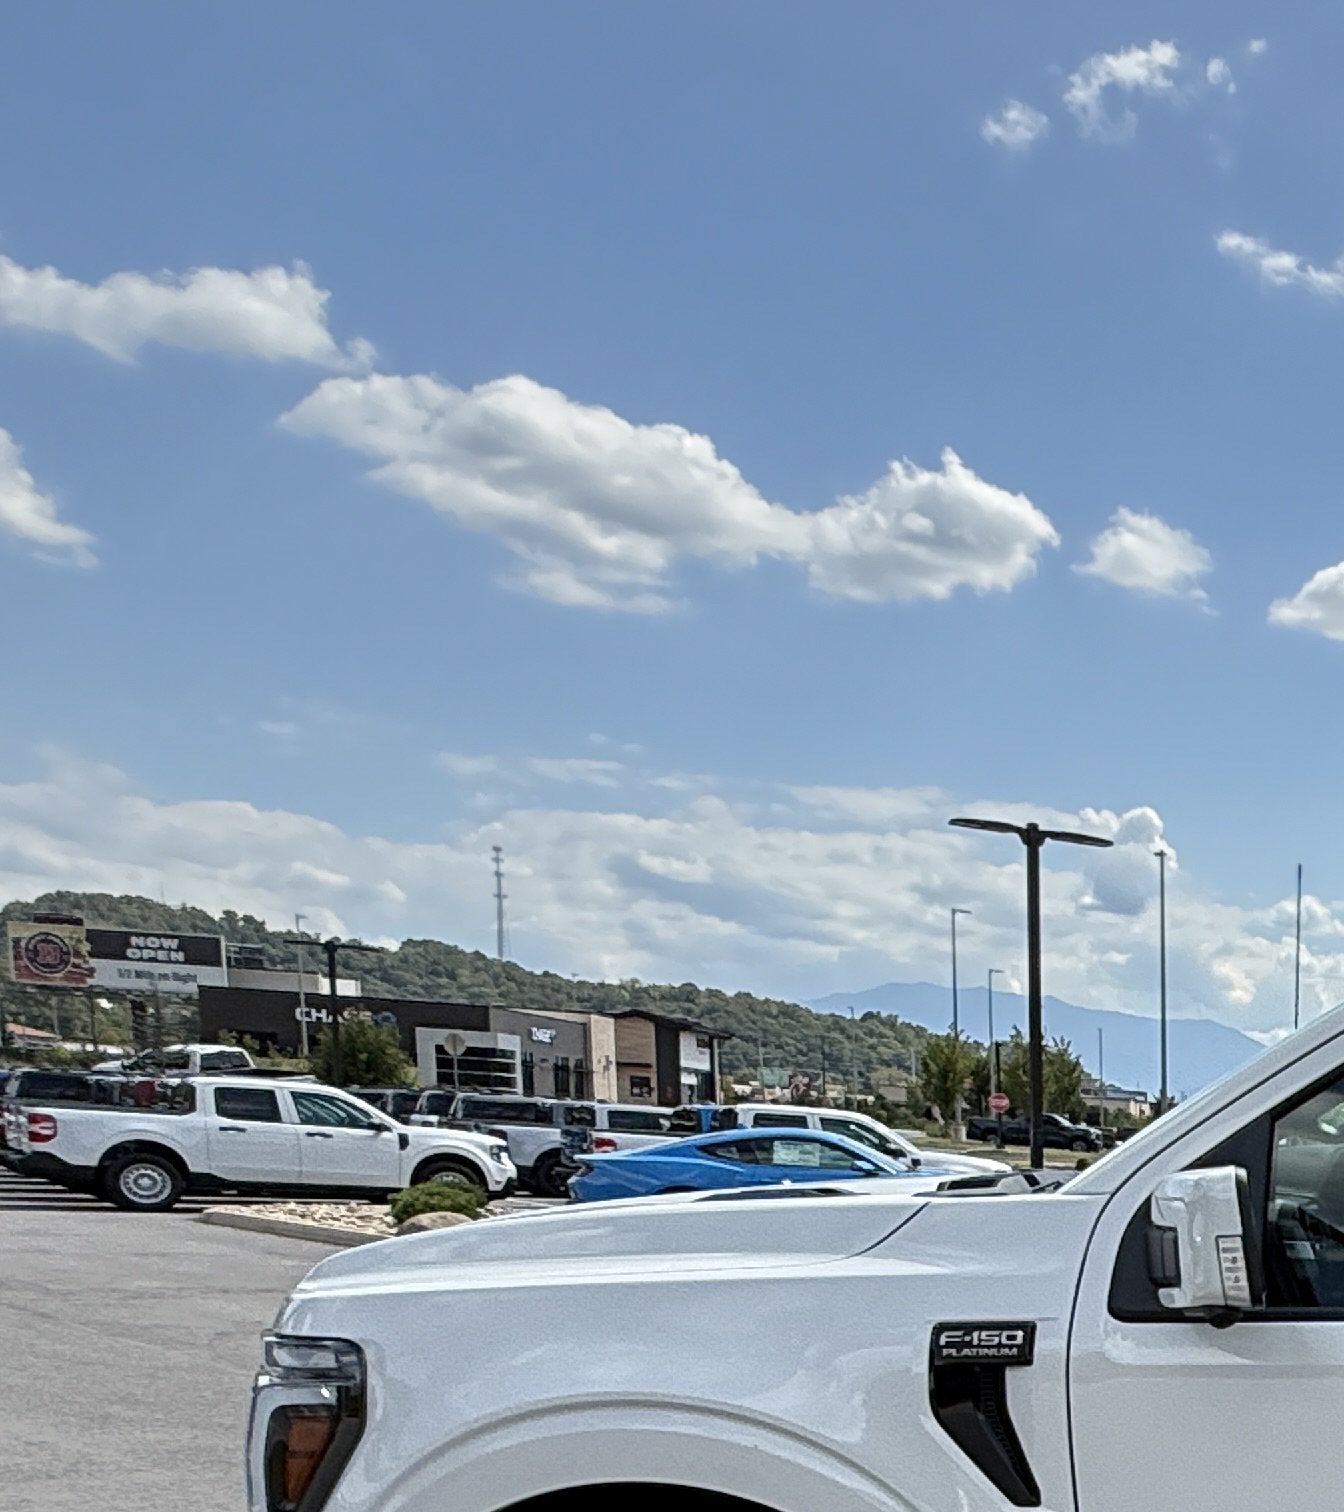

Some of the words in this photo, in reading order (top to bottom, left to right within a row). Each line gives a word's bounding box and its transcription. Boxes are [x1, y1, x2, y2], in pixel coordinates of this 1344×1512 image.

[129, 936, 180, 949] NOW
[125, 948, 186, 962] OPEN
[938, 1330, 1025, 1346] F-150
[942, 1348, 1018, 1358] PLATINUM
